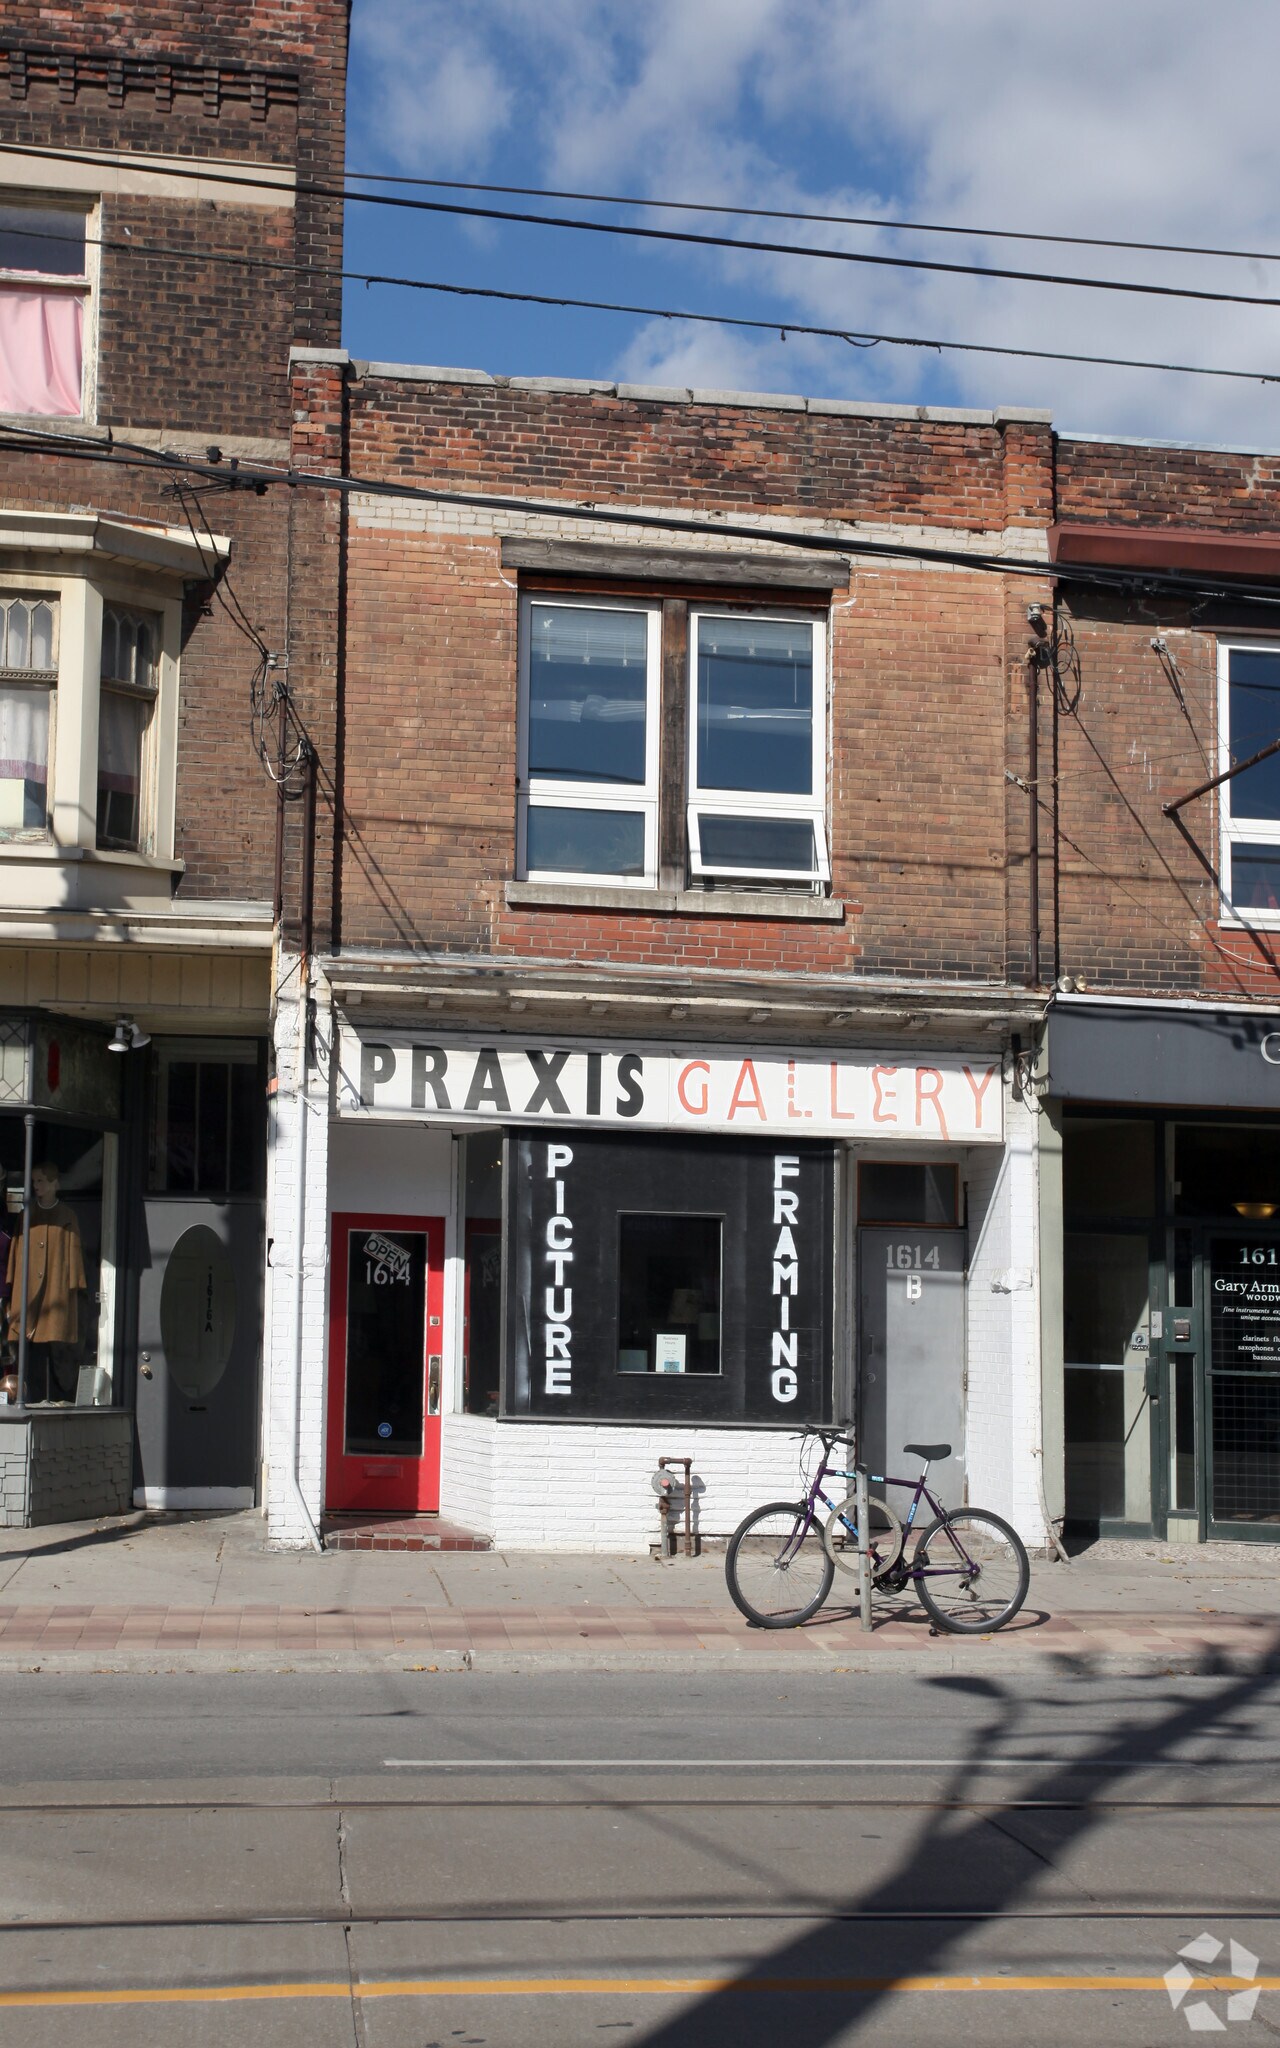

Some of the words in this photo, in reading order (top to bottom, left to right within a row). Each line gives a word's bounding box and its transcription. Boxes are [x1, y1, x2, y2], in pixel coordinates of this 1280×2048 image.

[360, 1042, 645, 1118] PRAXIS
[677, 1058, 998, 1141] GALLERY
[366, 1239, 407, 1270] OPEN
[886, 1244, 940, 1269] 1614
[1239, 1247, 1278, 1265] 161
[366, 1260, 411, 1286] 1614
[545, 1144, 574, 1395] PICTURE
[771, 1155, 800, 1403] FRAMING
[906, 1274, 922, 1299] B
[1214, 1278, 1249, 1295] Gary
[1250, 1280, 1280, 1293] Arm
[1222, 1306, 1235, 1314] fine
[1236, 1306, 1270, 1314] instruments
[1238, 1344, 1275, 1352] saxophones
